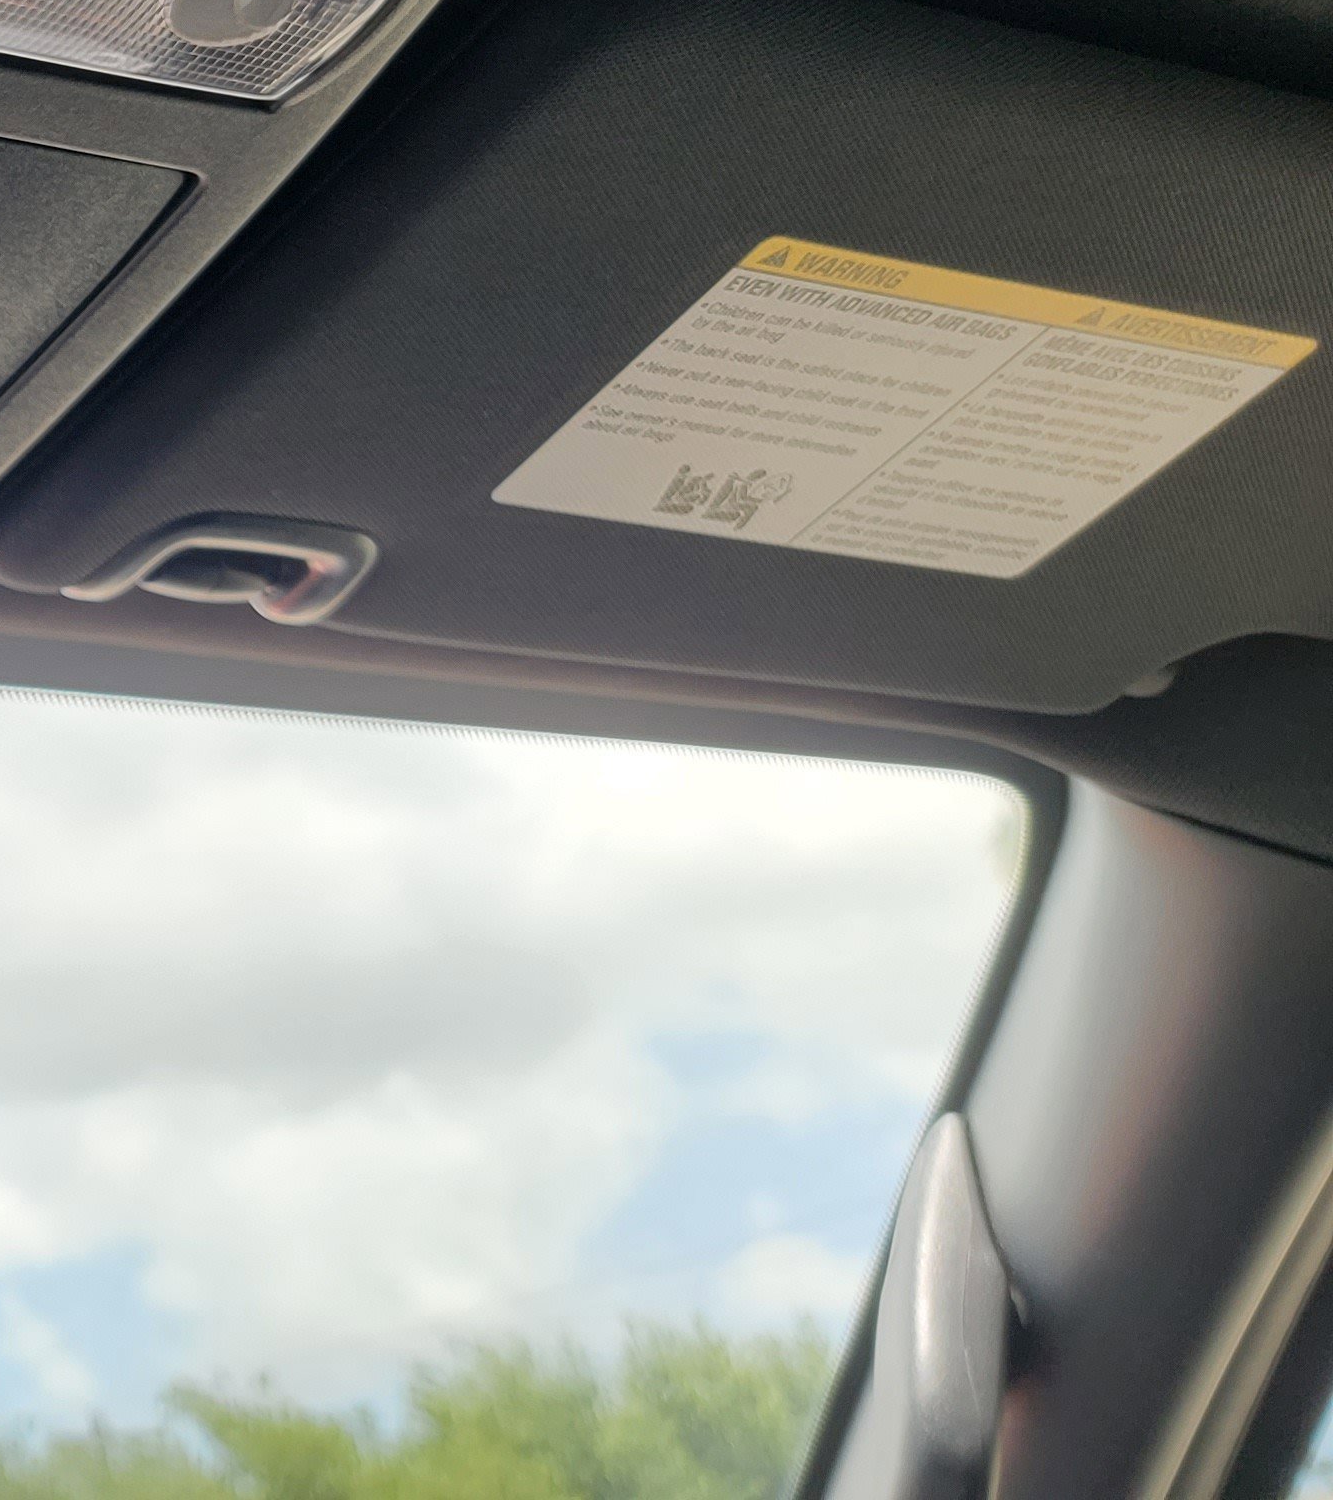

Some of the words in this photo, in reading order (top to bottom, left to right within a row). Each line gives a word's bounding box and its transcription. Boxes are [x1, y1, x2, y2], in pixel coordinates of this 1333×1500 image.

[795, 253, 907, 288] WARNING
[707, 301, 764, 320] Children
[764, 314, 792, 325] can
[791, 316, 812, 330] be
[724, 275, 781, 296] EVEN
[778, 284, 833, 306] WITH
[829, 296, 931, 324] ADVANCED
[928, 313, 966, 331] AIR
[961, 319, 1017, 340] BAGS
[690, 314, 712, 329] by
[710, 319, 735, 332] the
[755, 327, 786, 344] bag
[1110, 314, 1273, 353] AVERTISSEMENT
[669, 337, 694, 353] The
[693, 343, 729, 358] back
[729, 352, 763, 364] seat
[642, 361, 684, 377] Never
